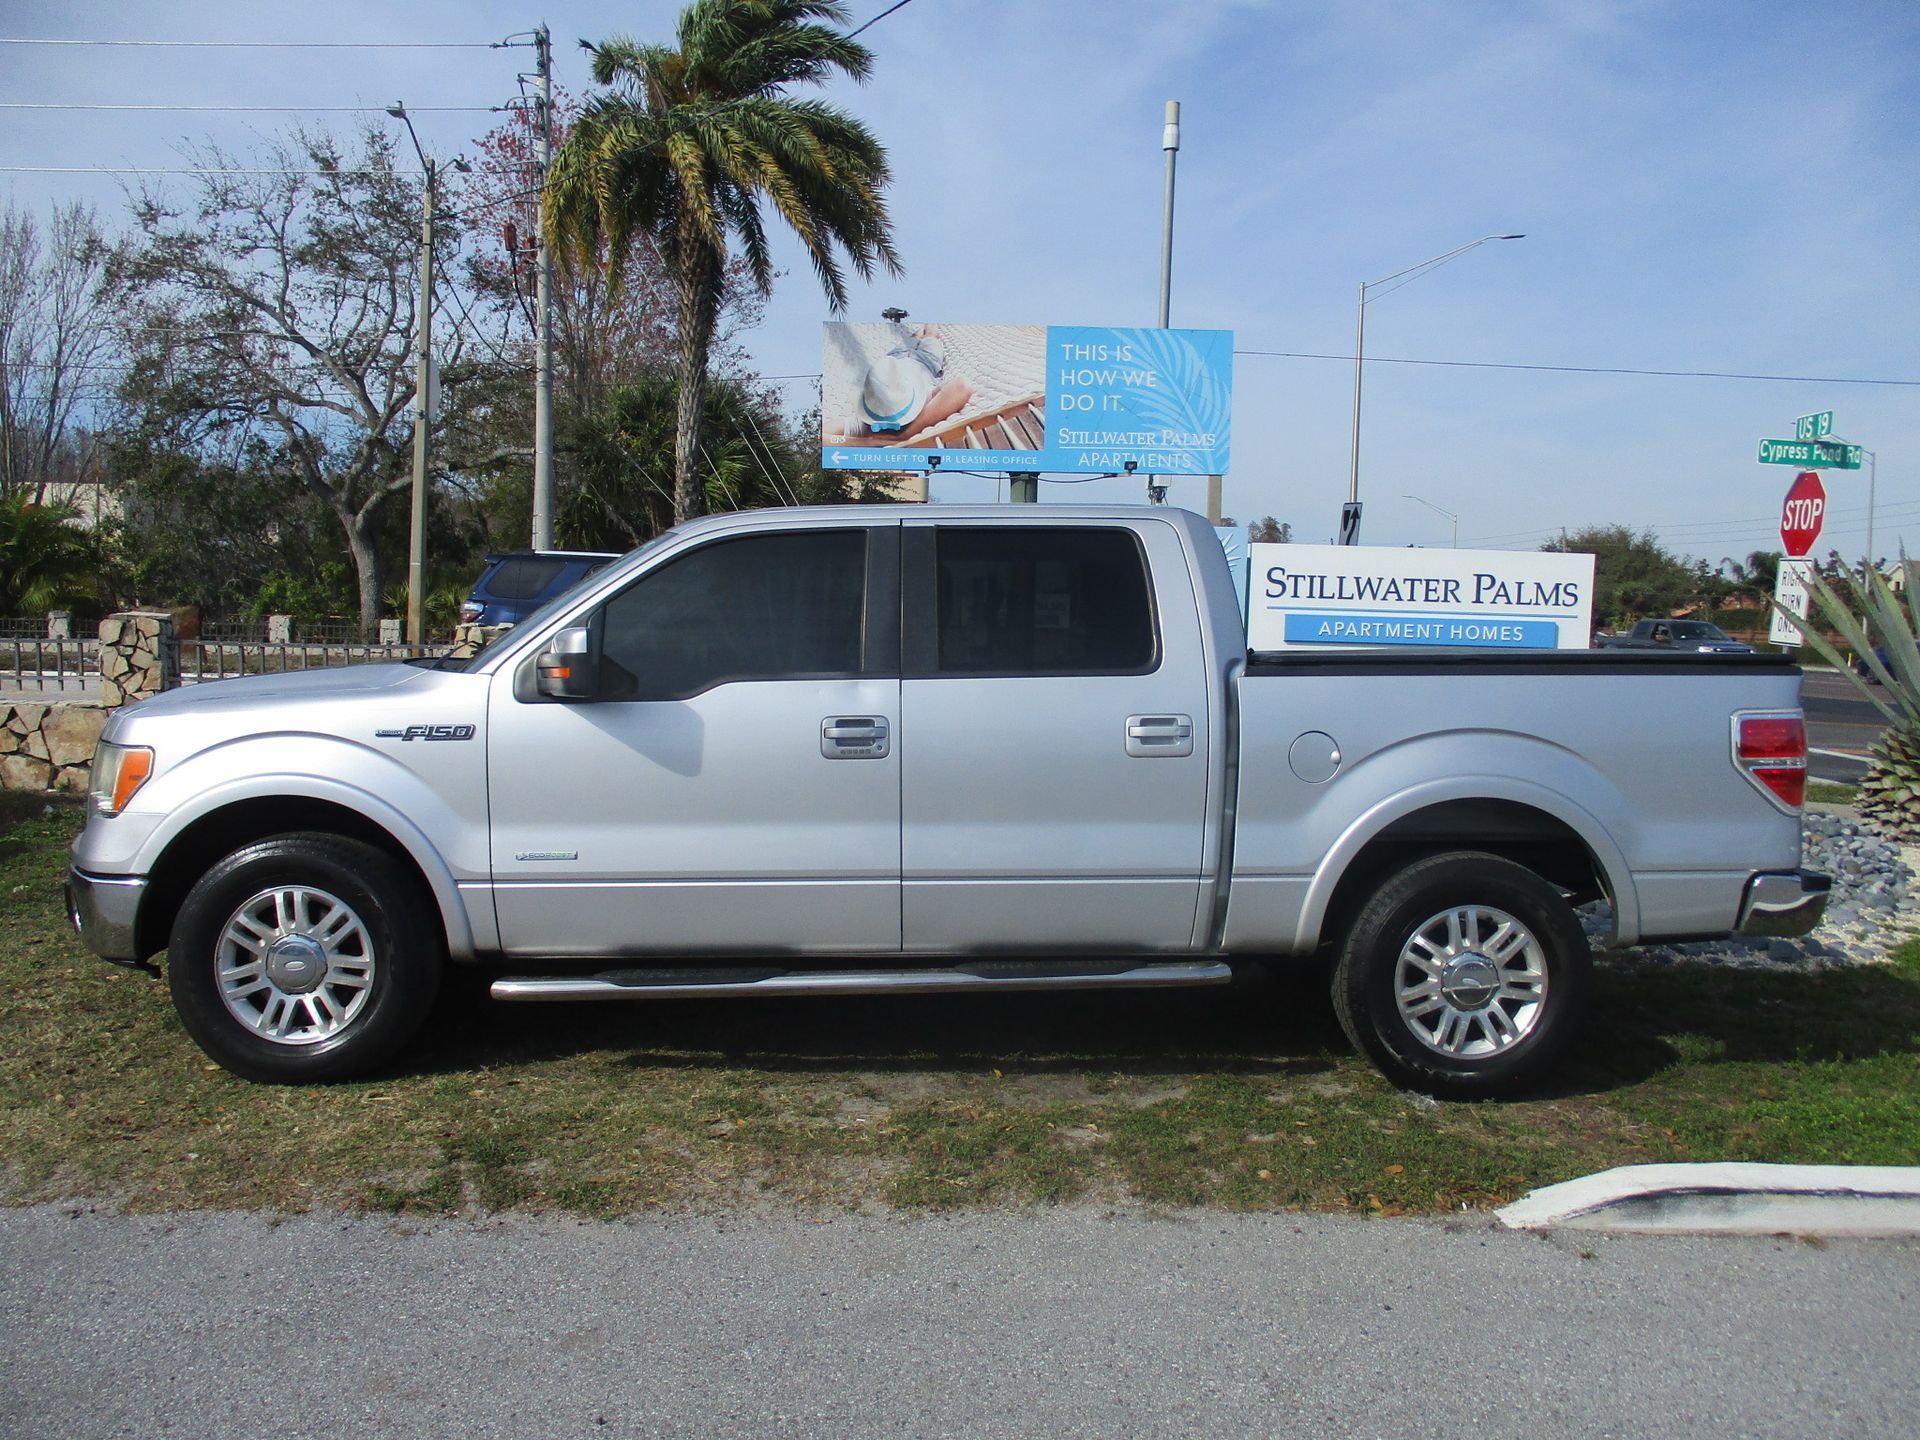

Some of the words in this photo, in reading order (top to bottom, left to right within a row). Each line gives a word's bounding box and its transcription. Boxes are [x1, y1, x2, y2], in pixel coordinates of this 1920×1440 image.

[1061, 344, 1107, 361] THIS
[1116, 345, 1132, 361] IS
[1061, 369, 1117, 386] HOW
[1122, 371, 1157, 387] WE
[1060, 394, 1094, 411] DO
[1103, 395, 1125, 412] IT.
[1798, 417, 1813, 439] US
[1818, 413, 1829, 435] 19
[1058, 428, 1156, 446] STILLWATER
[1161, 429, 1216, 447] PALMS
[853, 454, 881, 462] TURN
[885, 454, 907, 463] LEFT
[912, 455, 925, 463] TO
[955, 455, 998, 464] LEASING
[1002, 456, 1039, 465] OFFICE
[1078, 452, 1192, 468] APARTMENTS
[1760, 440, 1808, 462] Cypress
[1813, 444, 1842, 462] Pond
[1846, 446, 1861, 463] Rd
[1783, 498, 1823, 531] STOP
[1265, 566, 1460, 603] STILLWATER
[1471, 573, 1578, 608] PALMS
[1781, 593, 1802, 610] TURN
[1318, 620, 1444, 639] APARTMENT
[1450, 624, 1524, 642] HOMES
